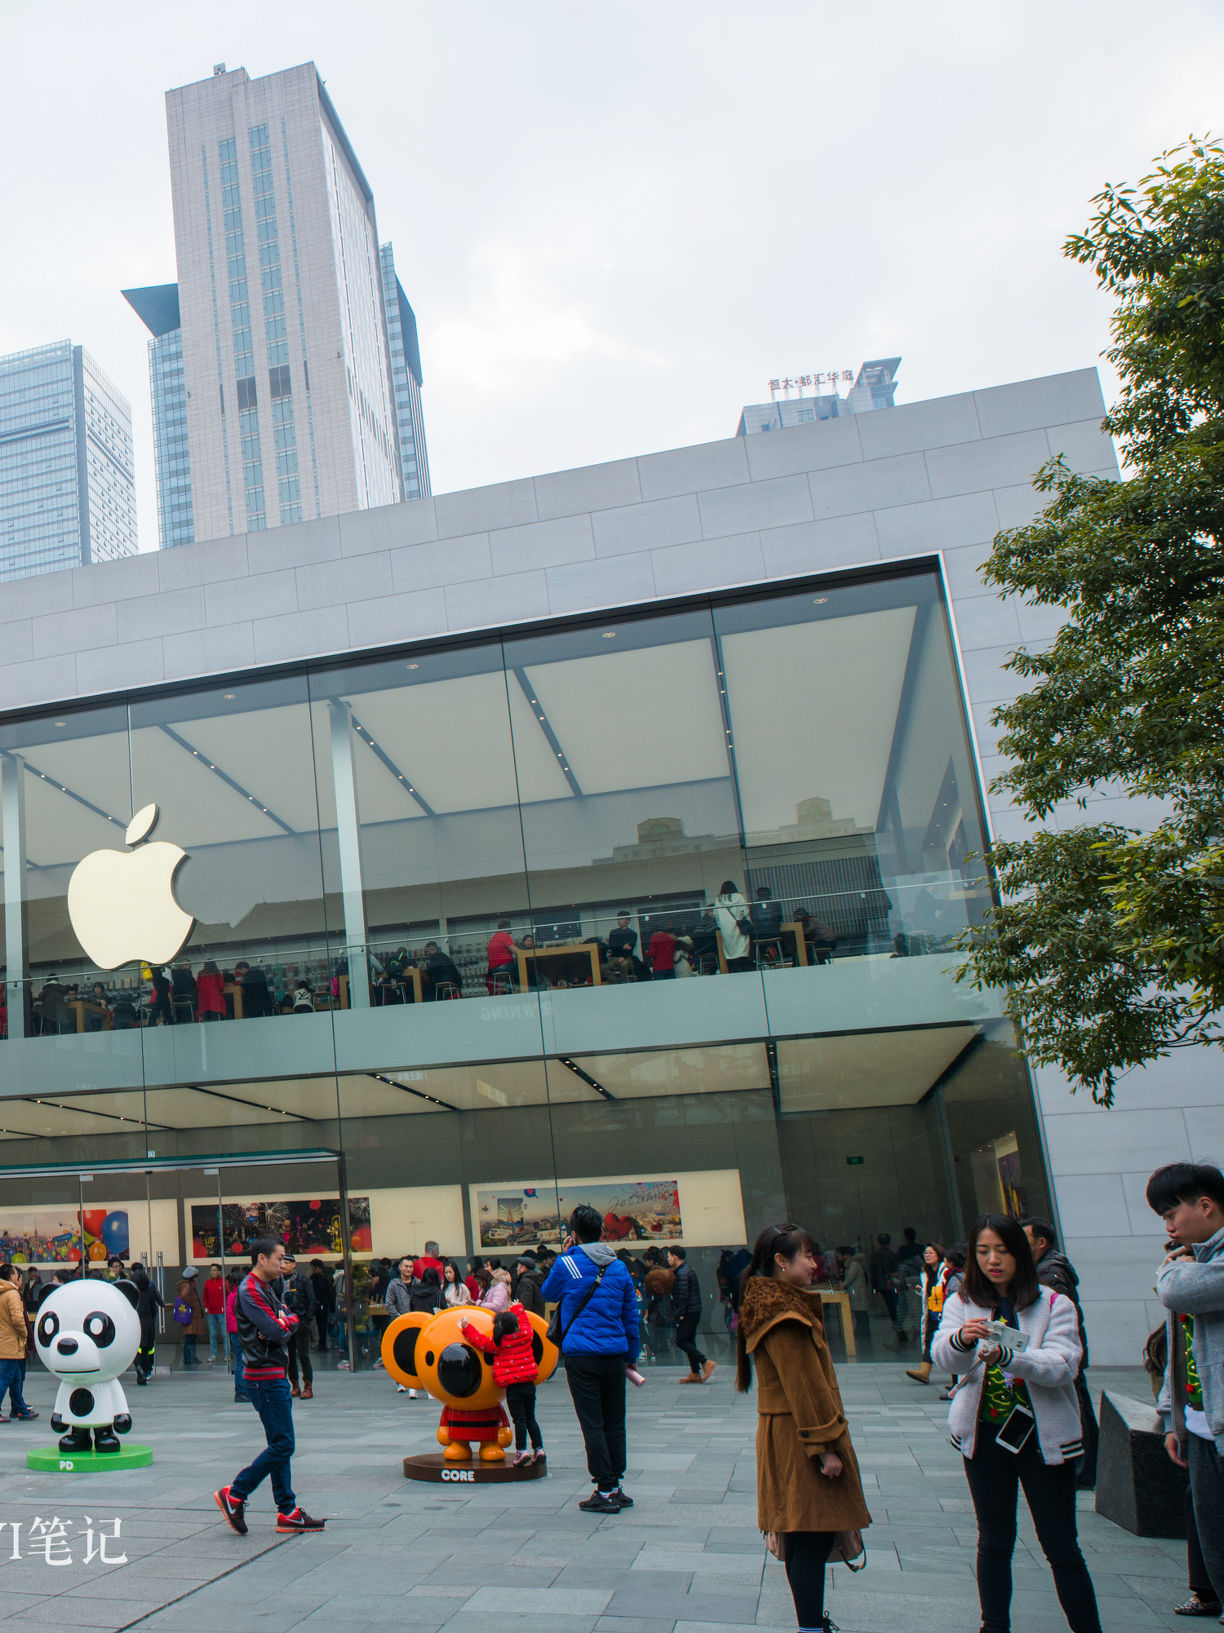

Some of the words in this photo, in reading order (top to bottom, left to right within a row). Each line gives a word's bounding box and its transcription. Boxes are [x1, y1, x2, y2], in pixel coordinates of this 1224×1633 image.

[768, 369, 854, 391] 恒大·都汇华庭
[59, 1460, 74, 1470] PD
[441, 1469, 475, 1482] CORE
